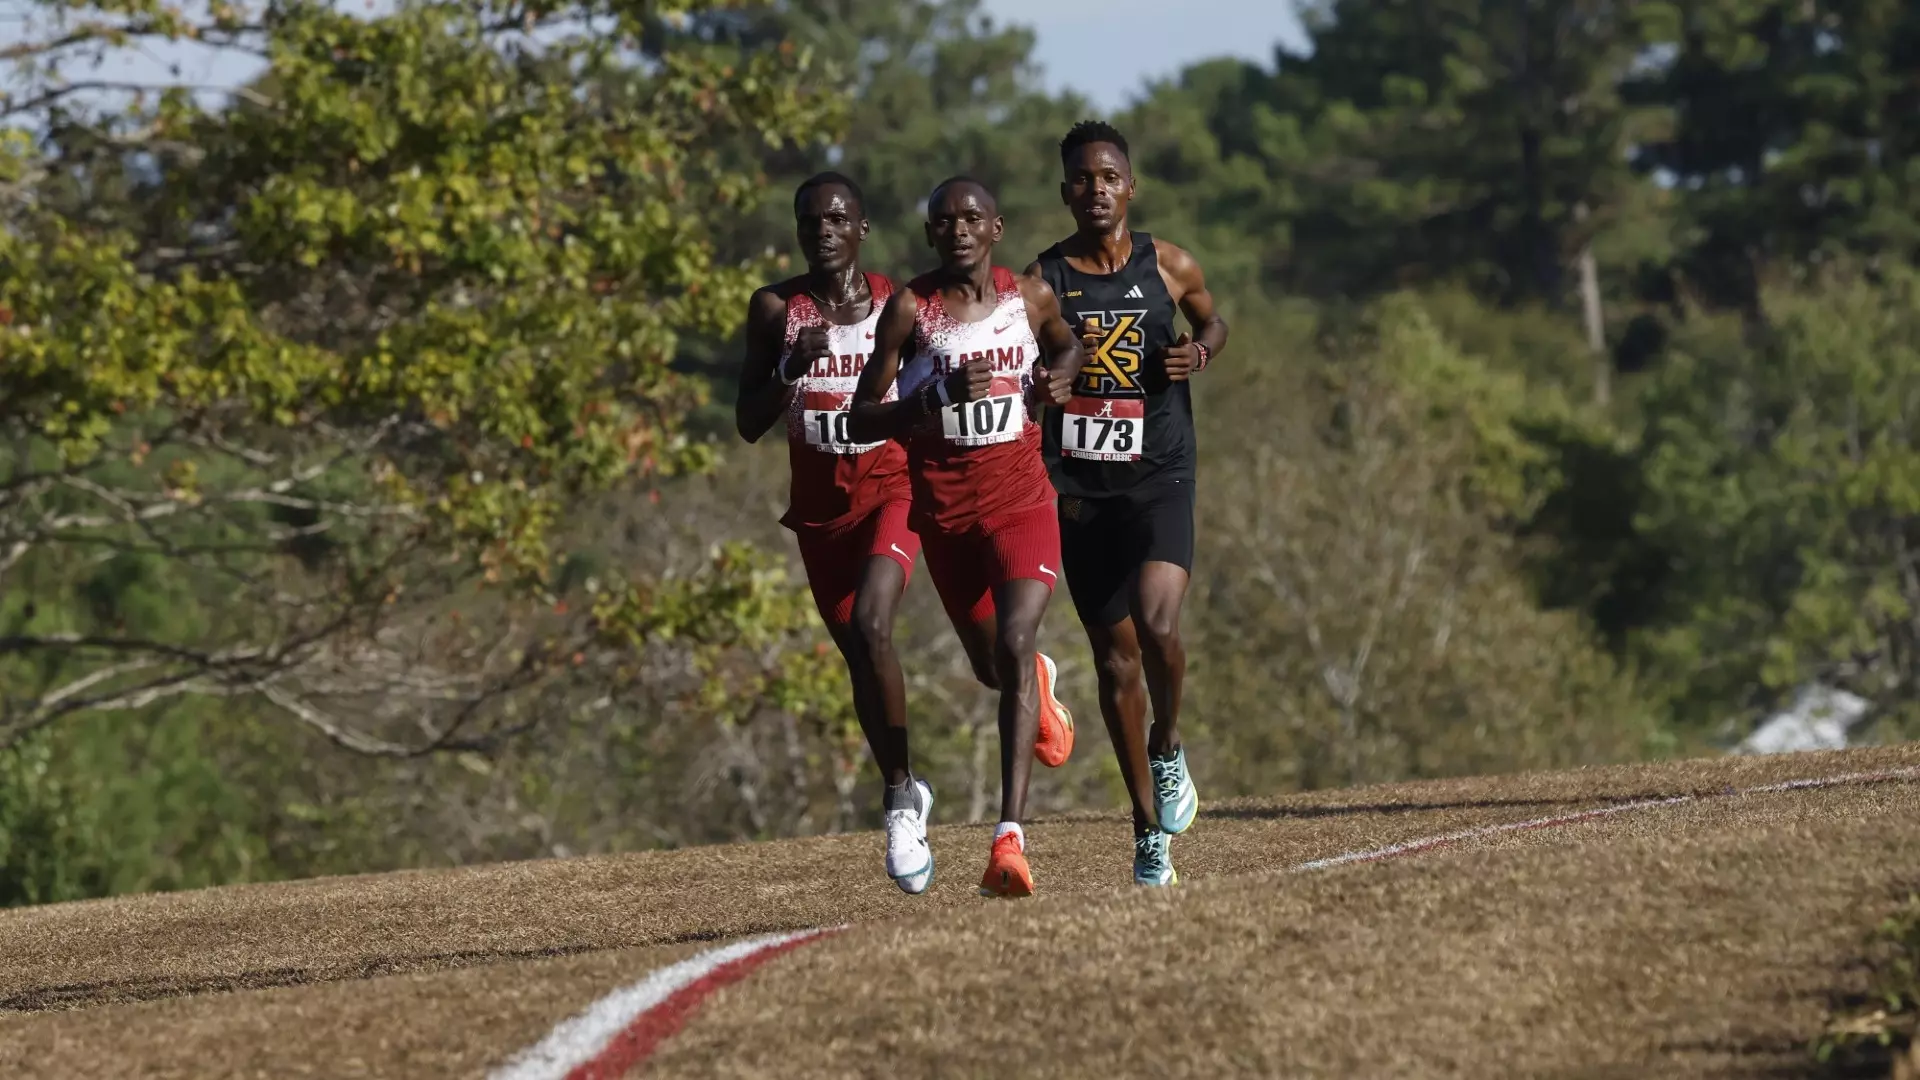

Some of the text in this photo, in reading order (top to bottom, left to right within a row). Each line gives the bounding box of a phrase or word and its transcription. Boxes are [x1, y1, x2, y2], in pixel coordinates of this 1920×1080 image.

[952, 396, 1013, 436] 107
[1073, 417, 1134, 452] 173
[1071, 450, 1132, 462] CRIMSON CLASSIC
